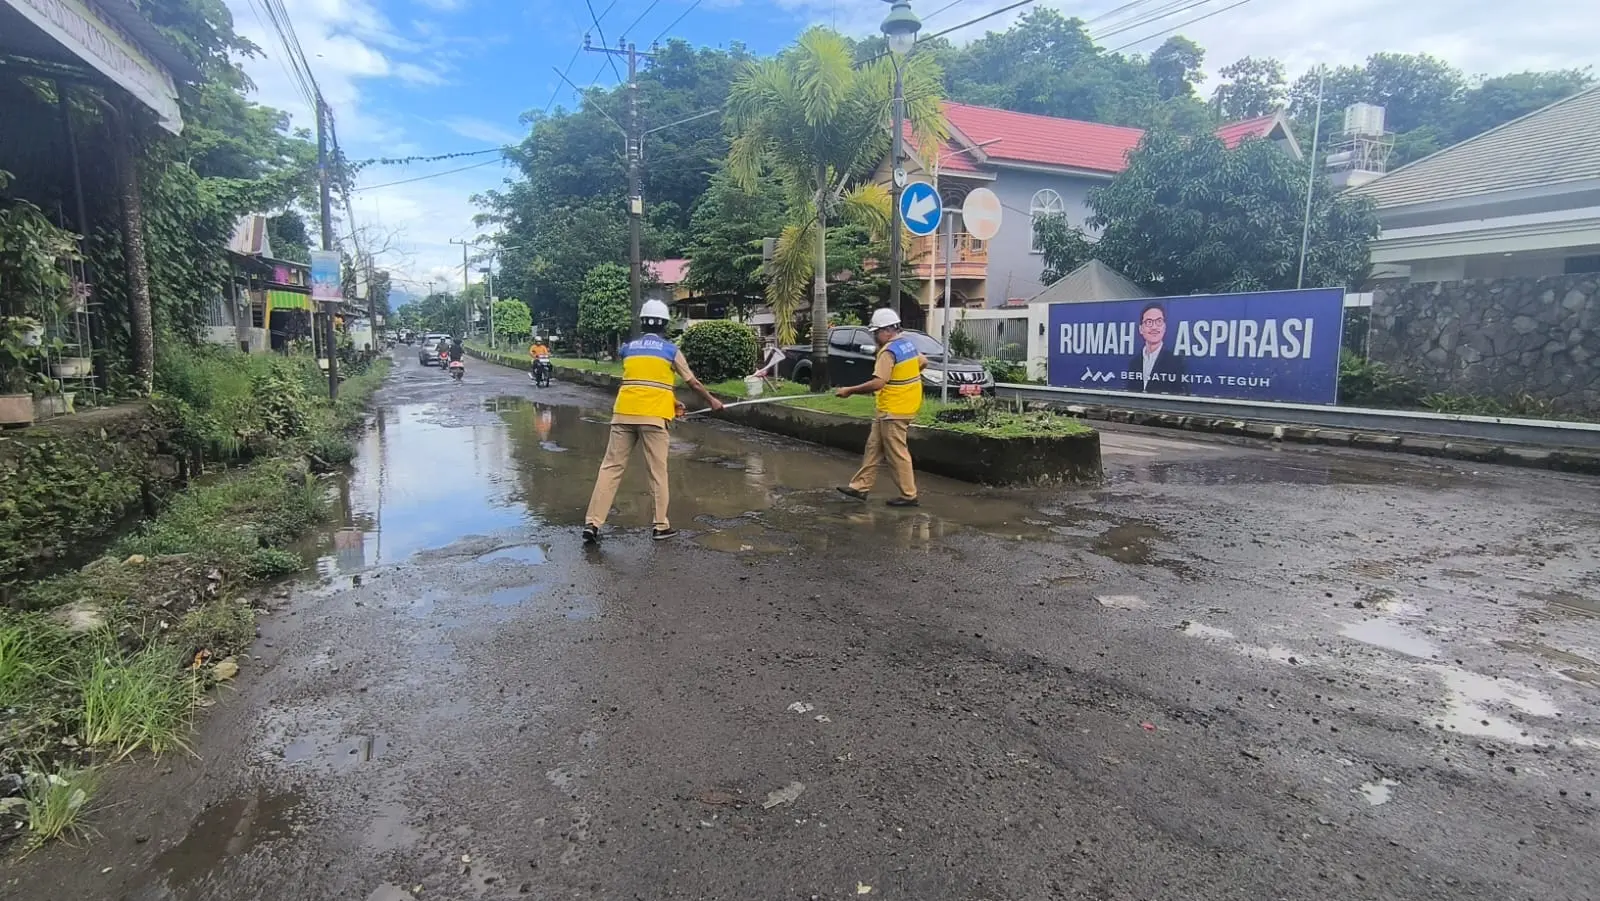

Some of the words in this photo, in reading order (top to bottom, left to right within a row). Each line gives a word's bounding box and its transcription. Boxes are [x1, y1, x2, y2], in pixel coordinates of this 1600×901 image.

[1060, 322, 1136, 355] RUMAH
[1173, 318, 1314, 359] ASPIRASI
[1181, 374, 1212, 385] KITA
[1218, 376, 1270, 387] TEGUH
